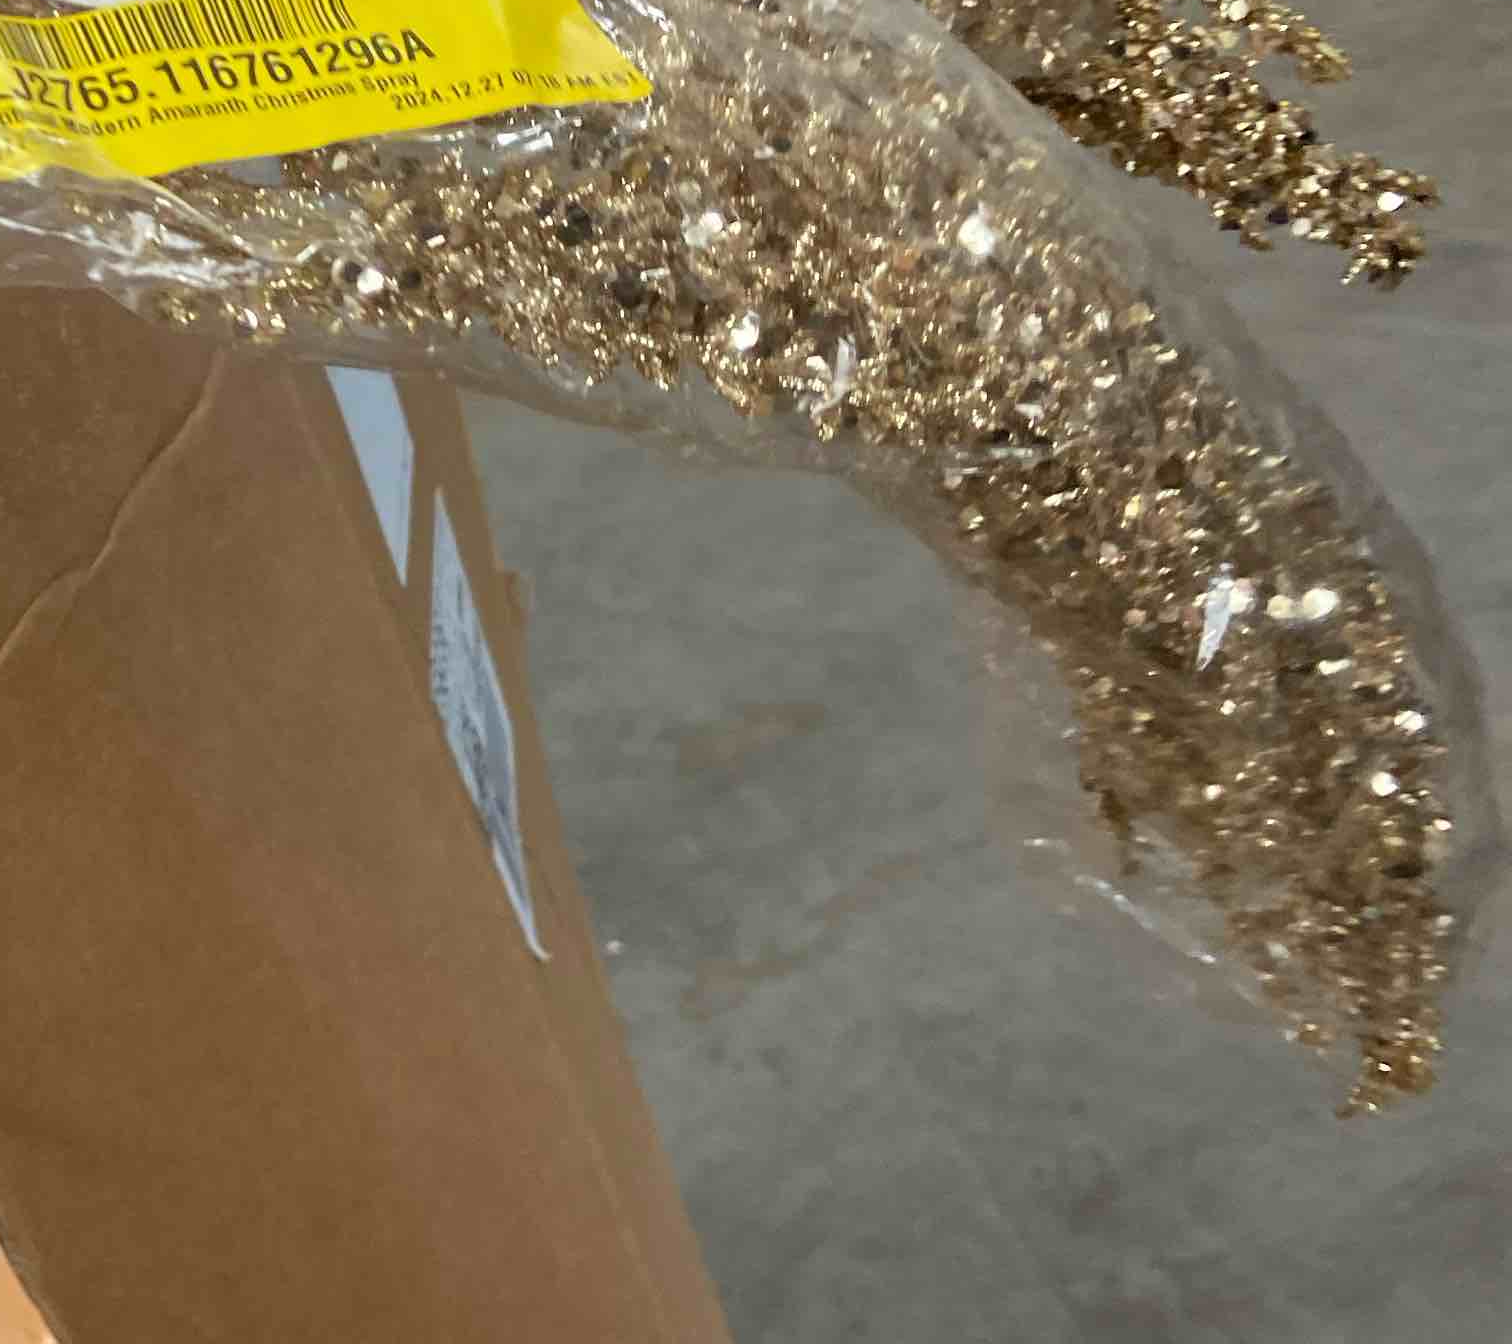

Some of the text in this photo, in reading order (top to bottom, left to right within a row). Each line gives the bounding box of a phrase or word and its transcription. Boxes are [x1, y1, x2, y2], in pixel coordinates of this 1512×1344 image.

[148, 95, 251, 126] Amaranth
[255, 73, 358, 112] Christmas
[363, 69, 422, 99] Spray
[390, 71, 506, 111] 2024.12.27
